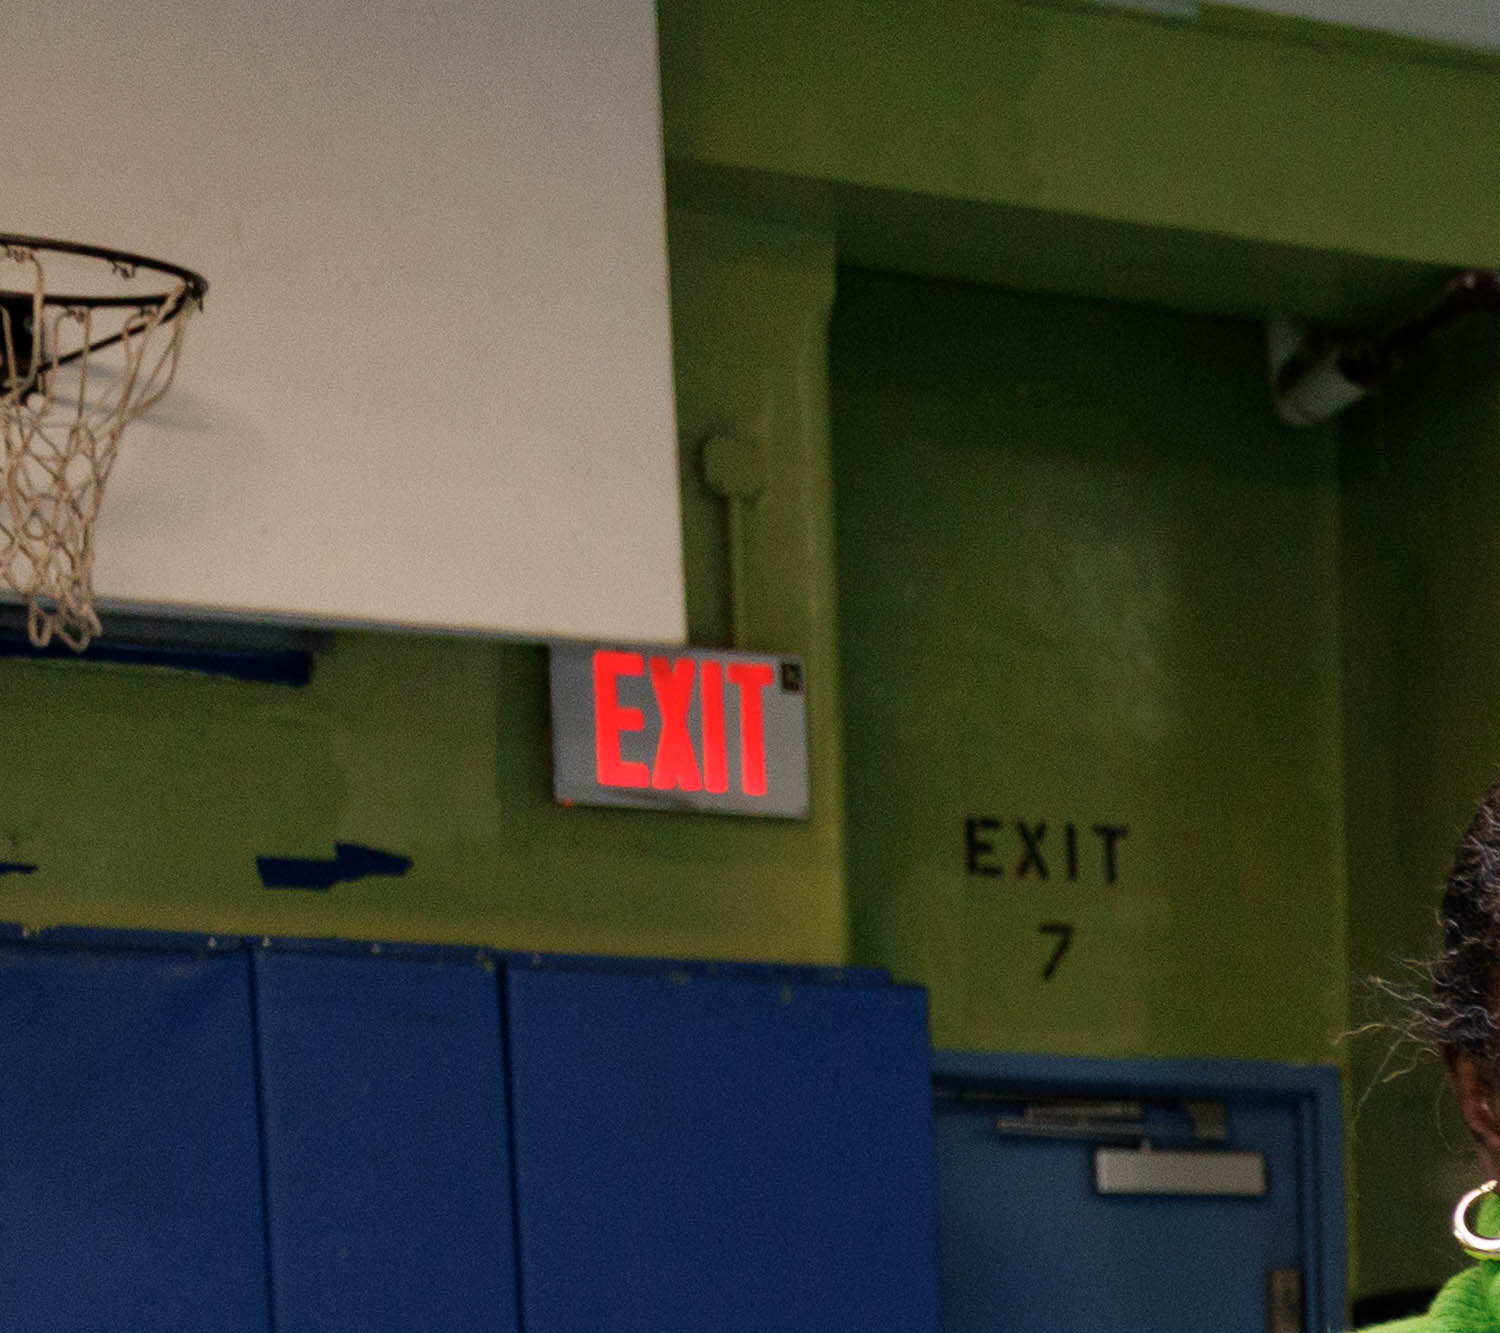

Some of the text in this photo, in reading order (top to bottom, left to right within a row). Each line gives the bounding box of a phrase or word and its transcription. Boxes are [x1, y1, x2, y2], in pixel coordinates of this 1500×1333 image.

[592, 650, 774, 797] EXIT
[964, 815, 1130, 885] EXIT
[1038, 923, 1075, 981] 7
